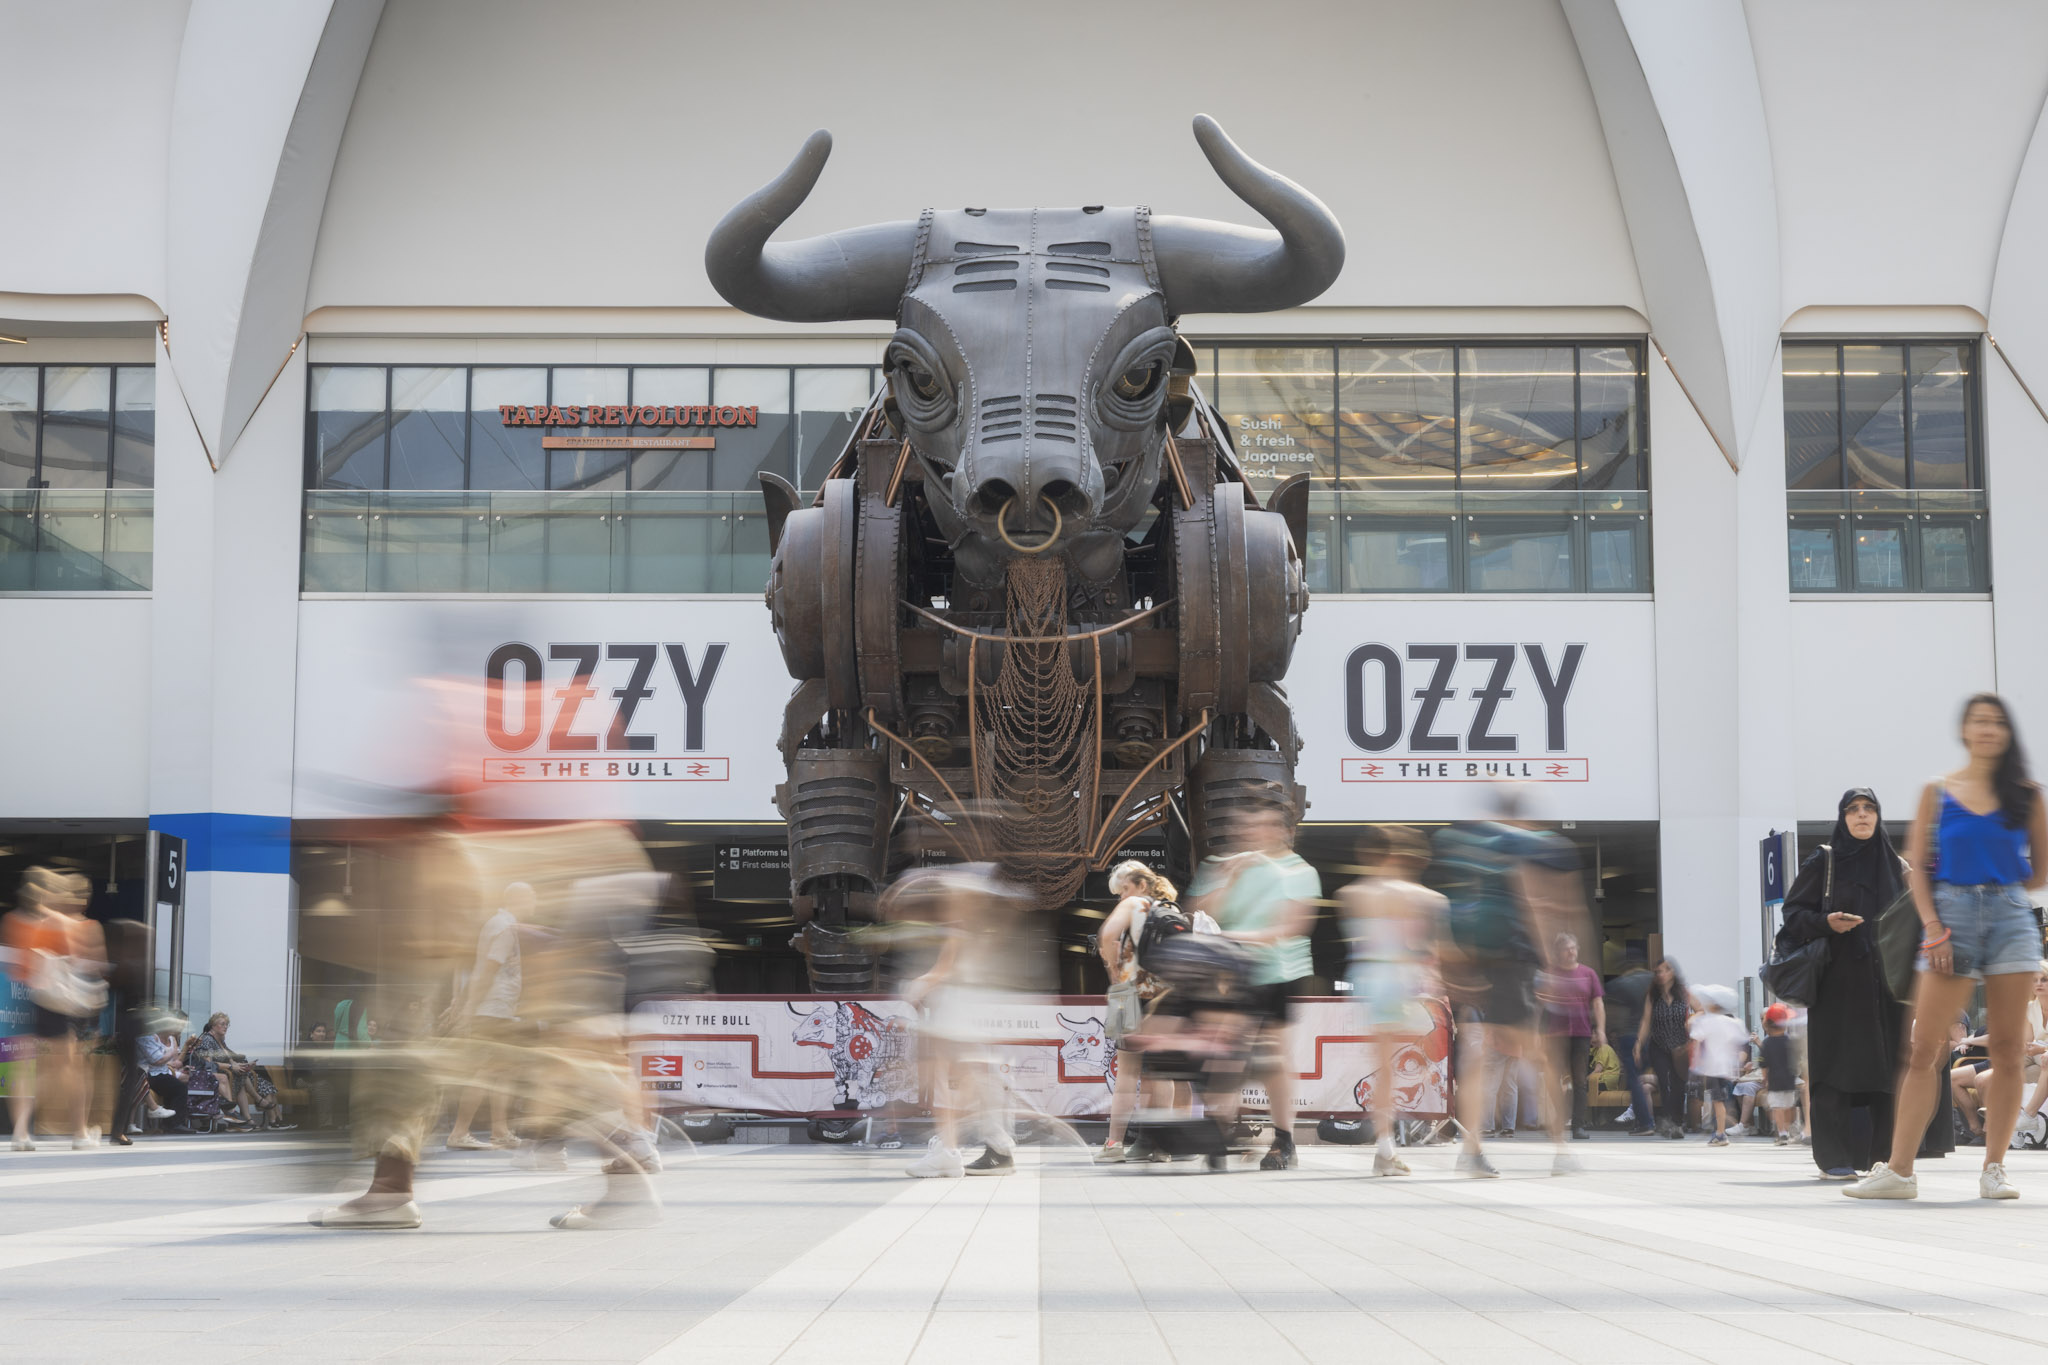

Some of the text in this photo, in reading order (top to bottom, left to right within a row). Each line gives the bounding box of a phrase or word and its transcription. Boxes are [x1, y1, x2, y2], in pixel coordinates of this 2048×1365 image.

[499, 405, 759, 427] TAPAS REVOLUTION
[1240, 418, 1282, 430] Sushi
[633, 438, 691, 447] RESTAURANT
[1240, 434, 1295, 447] & fresh
[1241, 451, 1314, 464] Japanese
[1241, 466, 1275, 478] food
[484, 641, 729, 753] OZZY
[1344, 641, 1588, 754] OZZY
[540, 762, 673, 776] THE BULL
[1398, 763, 1532, 777] THE BULL
[742, 849, 788, 857] Platforms 1a
[926, 849, 947, 857] Taxis
[1118, 849, 1149, 857] latforms
[167, 849, 178, 889] 5
[742, 861, 760, 869] First
[760, 861, 780, 869] class
[1767, 851, 1775, 886] 6
[662, 1014, 751, 1026] OZZY THE BULL
